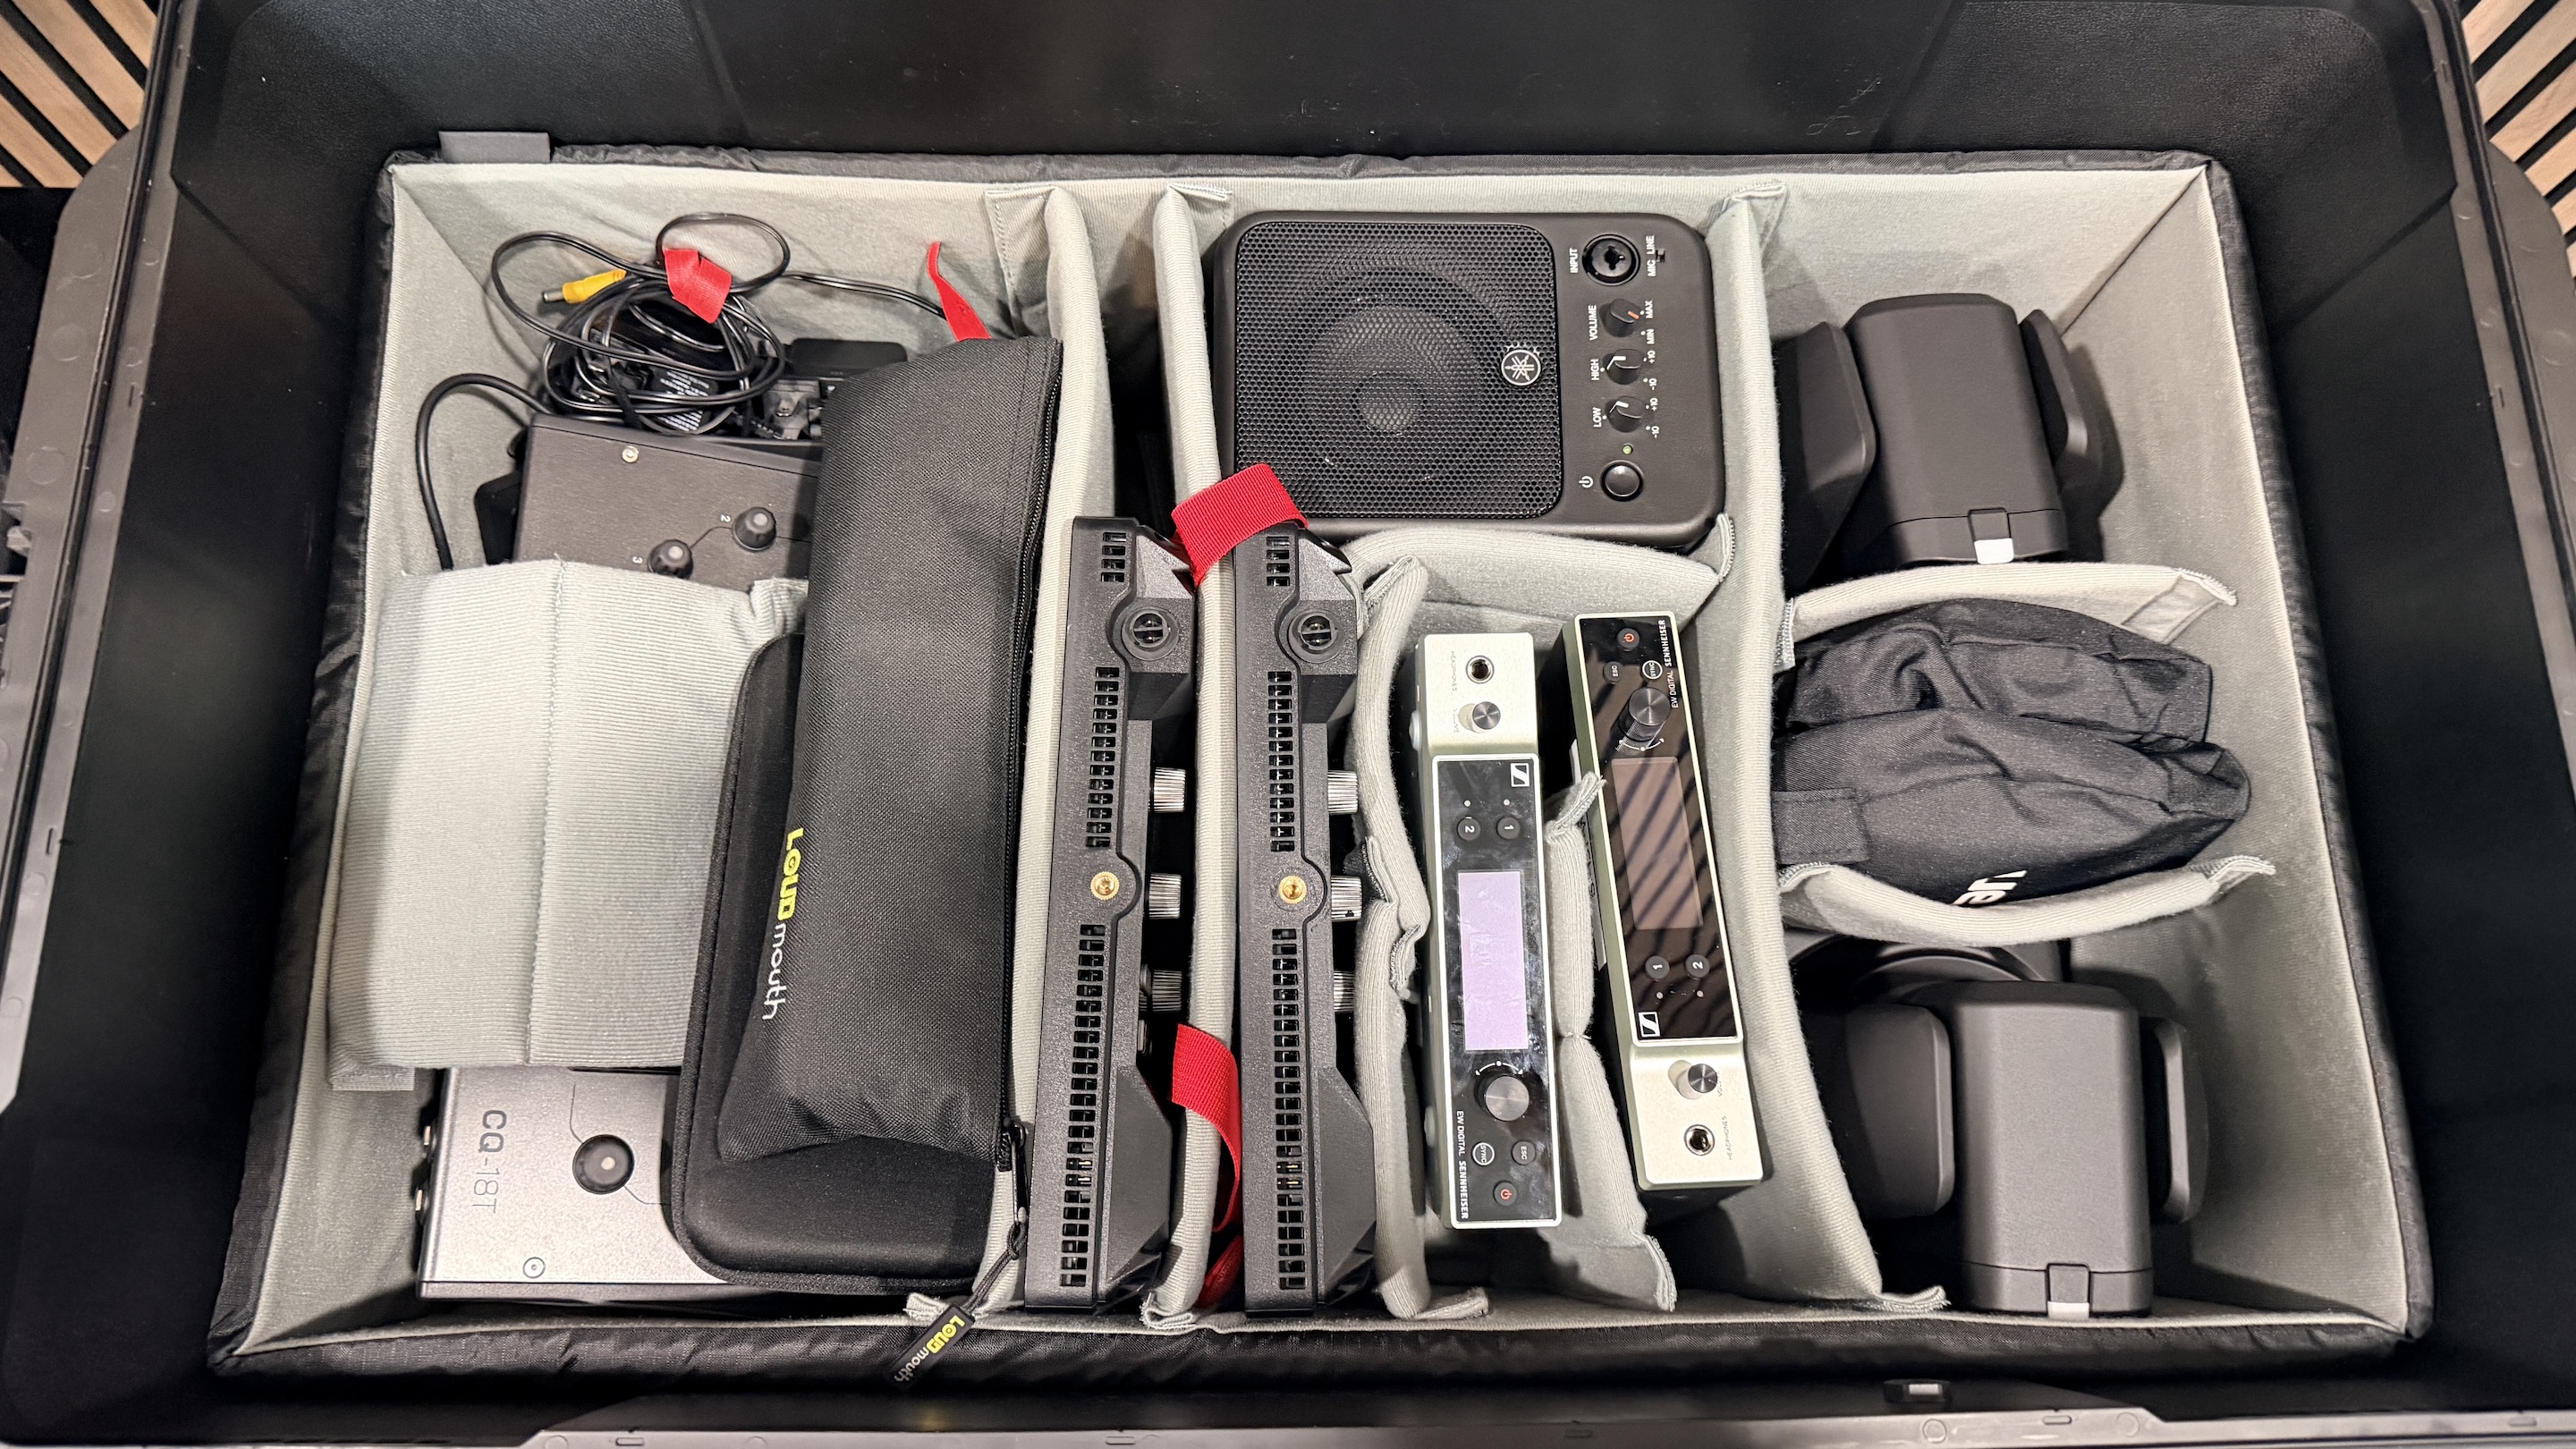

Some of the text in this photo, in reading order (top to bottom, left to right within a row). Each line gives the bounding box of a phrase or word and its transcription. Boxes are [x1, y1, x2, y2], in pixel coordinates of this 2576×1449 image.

[1569, 248, 1578, 274] INPUT
[1646, 235, 1656, 276] MIC LINE
[1645, 300, 1653, 318] MAX
[1588, 305, 1598, 341] VOLUME
[1647, 328, 1655, 344] MIN
[1648, 350, 1656, 363] +10
[1590, 359, 1600, 380] HIGH
[1648, 377, 1657, 390] -10
[1649, 397, 1658, 411] +10
[1592, 407, 1602, 428] LOW
[1651, 426, 1660, 438] -10
[721, 514, 731, 523] 2
[632, 555, 643, 564] 3
[1611, 665, 1619, 677] ESC
[1648, 662, 1657, 677] SYNC
[1657, 619, 1679, 708] EW DIGITAL SENNHEISER
[1464, 825, 1476, 834] 2
[1692, 961, 1704, 970] 2
[471, 1109, 507, 1214] CQ-18T
[1479, 1145, 1487, 1163] SYNC
[1456, 1110, 1470, 1220] EW DIGITAL SENNHEISER
